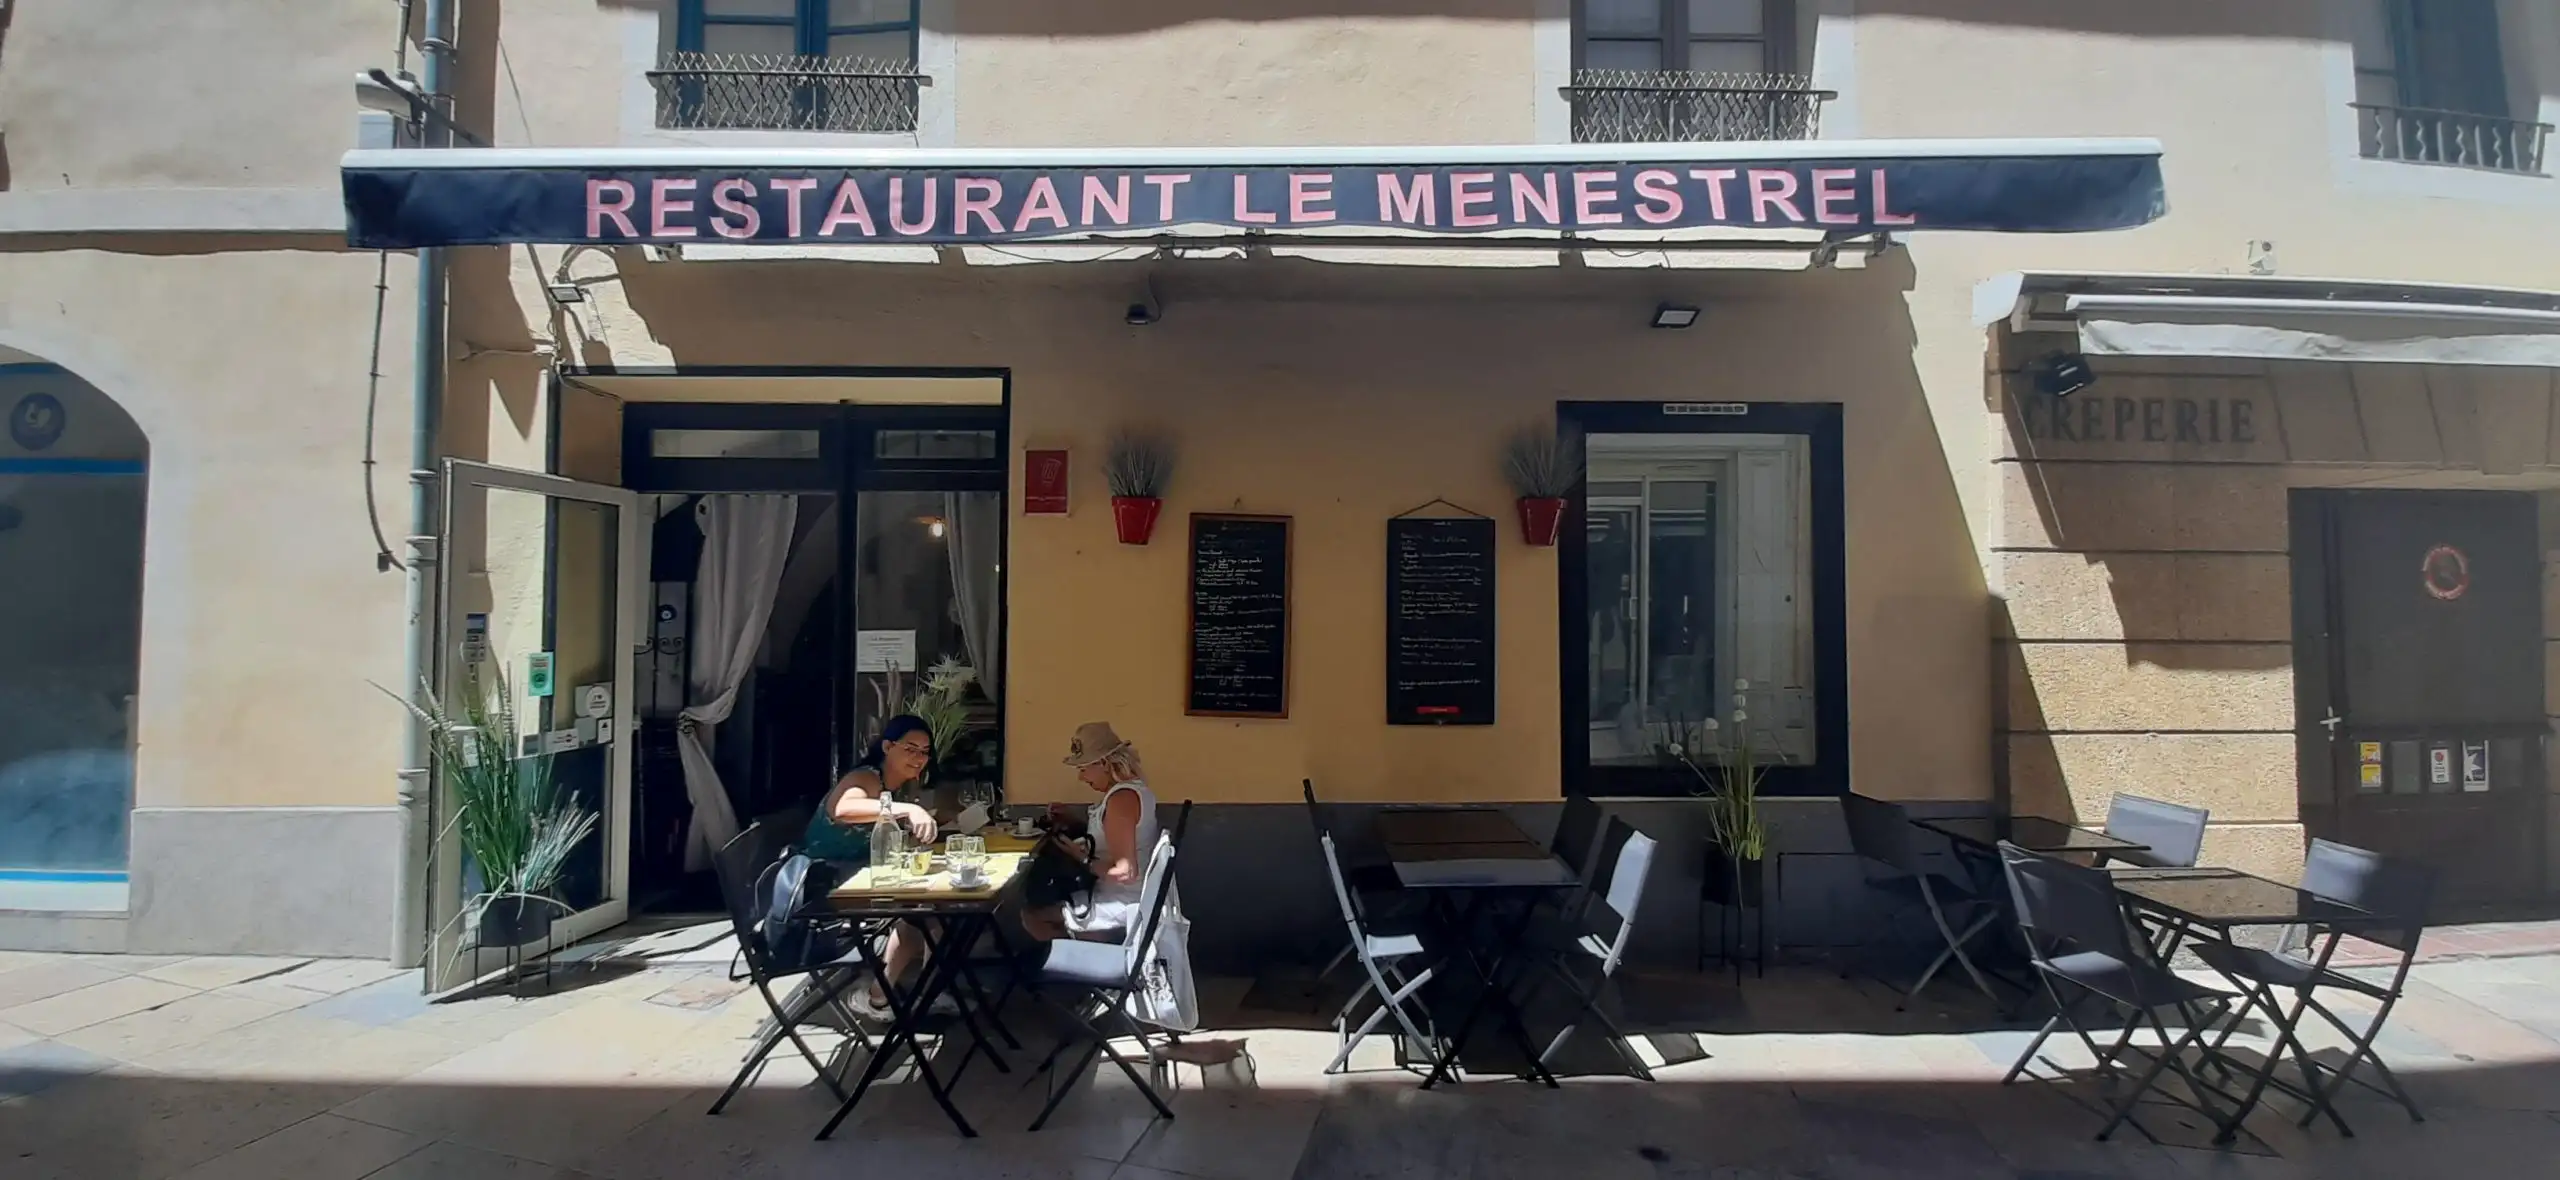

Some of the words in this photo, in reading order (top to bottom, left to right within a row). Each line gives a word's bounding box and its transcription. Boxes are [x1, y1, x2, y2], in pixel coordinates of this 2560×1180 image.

[586, 174, 1191, 239] RESTAURANT
[1233, 172, 1337, 223] LE
[1377, 168, 1916, 227] MENESTREL
[2025, 397, 2256, 443] CREPERIE
